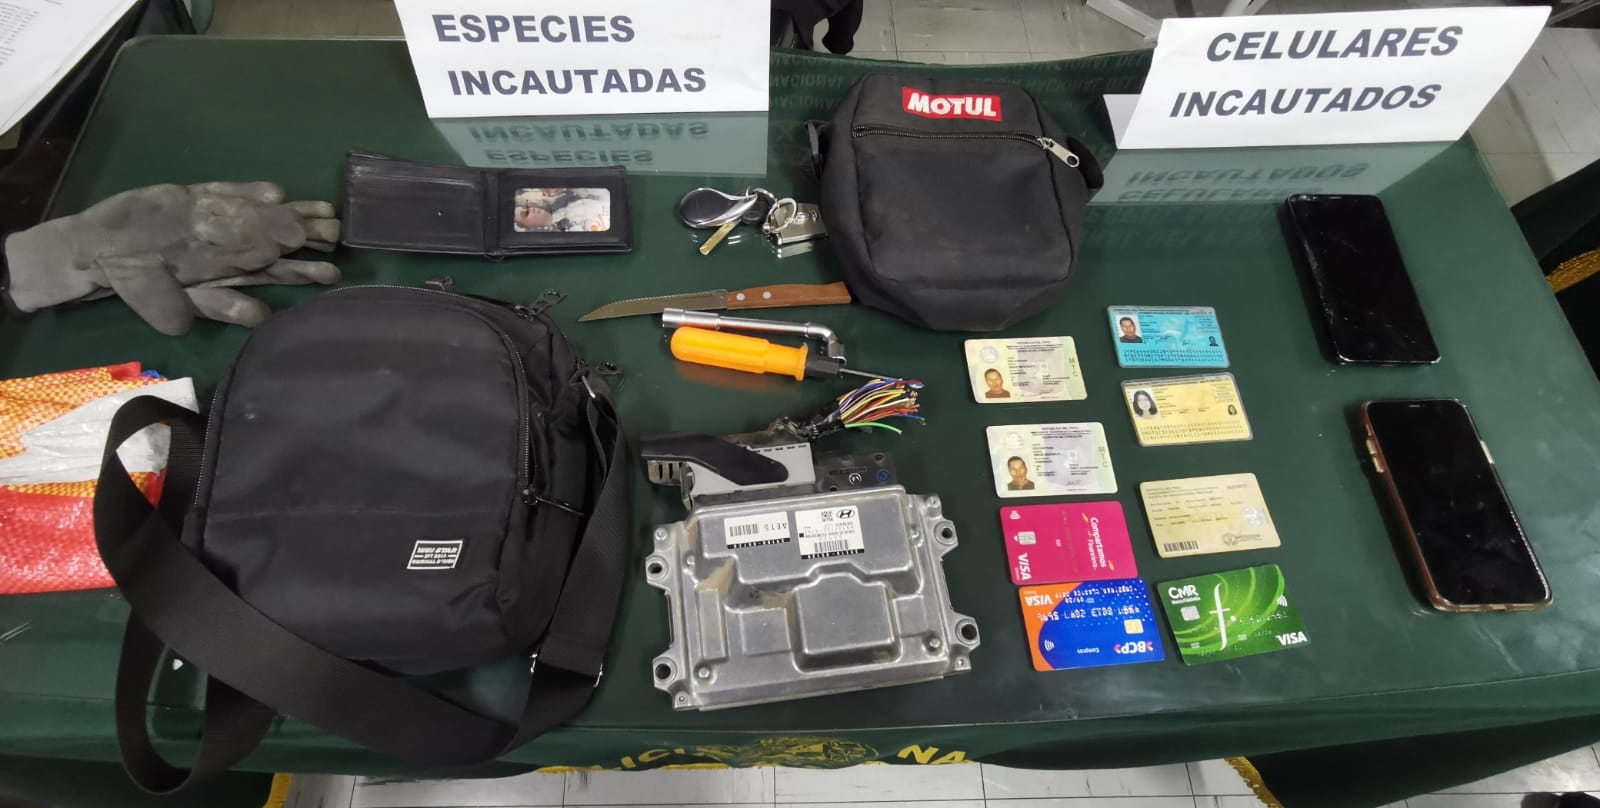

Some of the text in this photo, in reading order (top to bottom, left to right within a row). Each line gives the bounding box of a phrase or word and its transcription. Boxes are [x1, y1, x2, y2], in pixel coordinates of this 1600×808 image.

[432, 14, 635, 43] ESPECIES
[1207, 26, 1463, 62] CELULARES
[448, 68, 706, 96] INCAUTADAS
[907, 92, 997, 117] MOTUL
[1170, 84, 1442, 117] INCAUTADOS
[1090, 517, 1107, 568] Compartamos
[1018, 552, 1032, 581] VISA
[1025, 595, 1054, 606] VISA
[1168, 585, 1200, 599] CMR
[1120, 641, 1146, 655] BCP
[1275, 631, 1308, 646] VISA
